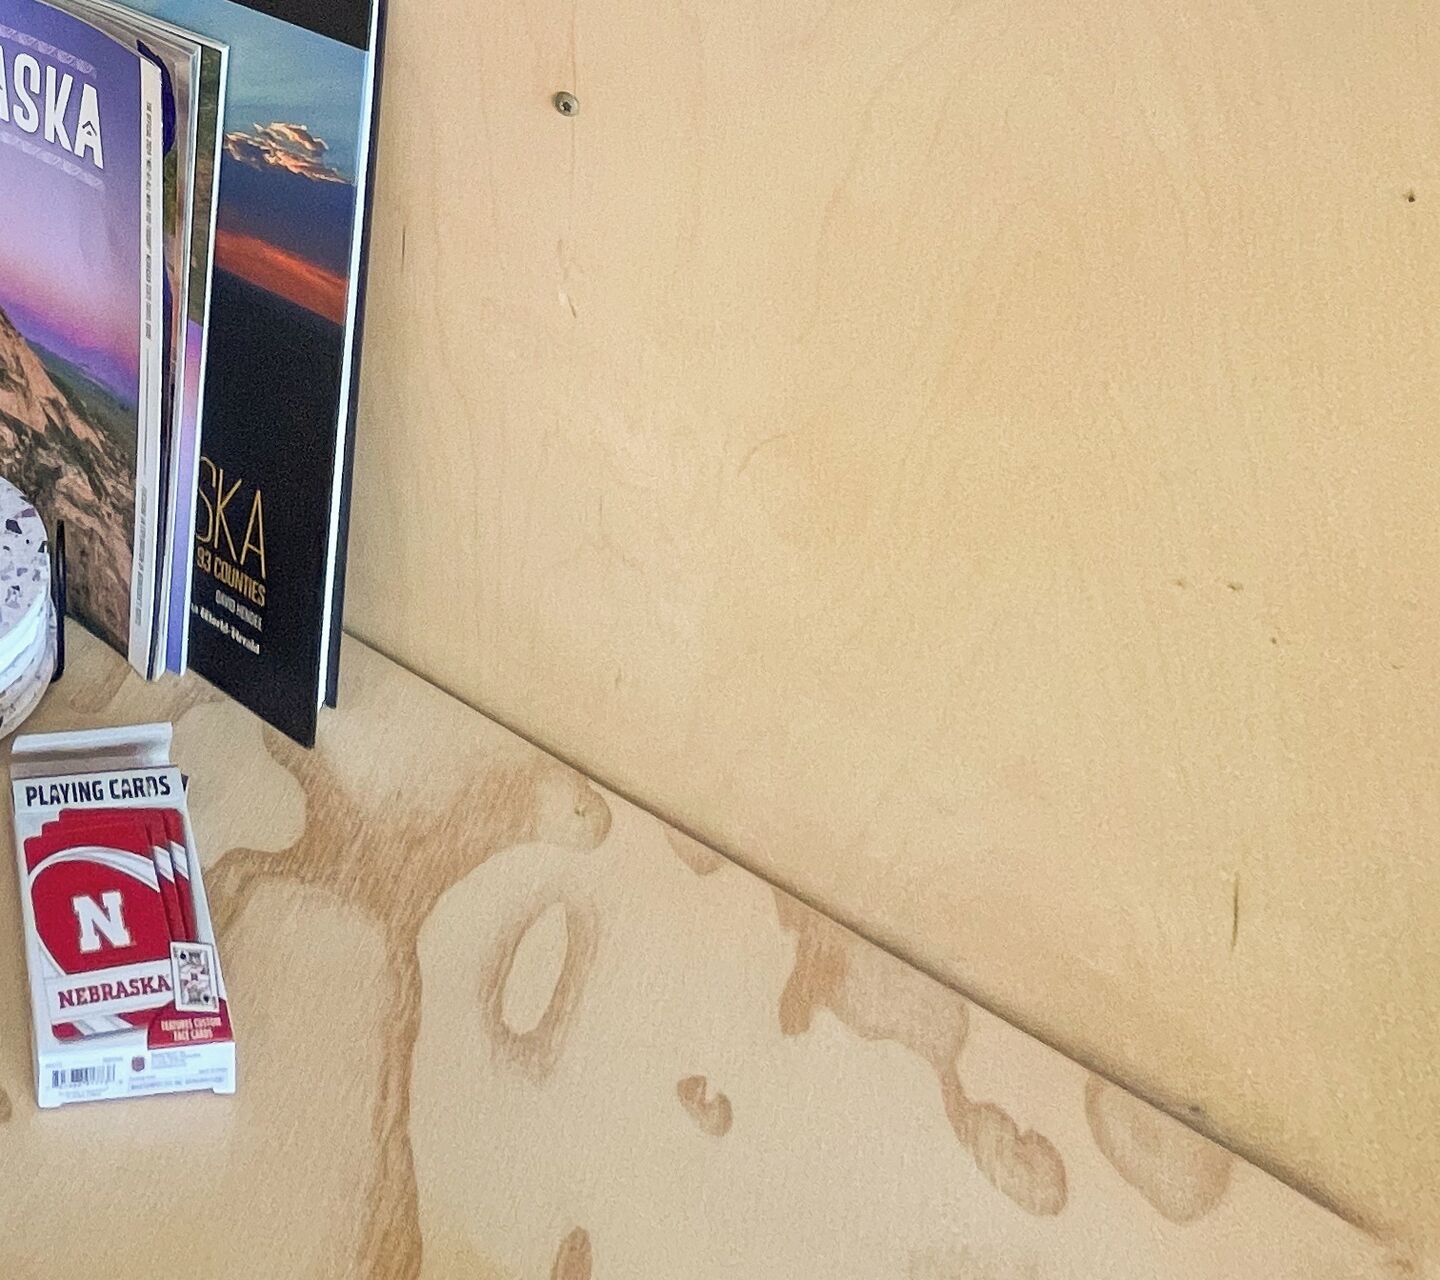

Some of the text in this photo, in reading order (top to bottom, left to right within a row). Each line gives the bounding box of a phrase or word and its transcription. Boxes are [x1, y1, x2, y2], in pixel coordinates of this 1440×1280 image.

[197, 545, 266, 608] 93 COUNTIES
[25, 775, 171, 807] PLAYING CARDS
[72, 891, 132, 955] N
[57, 974, 171, 1010] NEBRASKA
